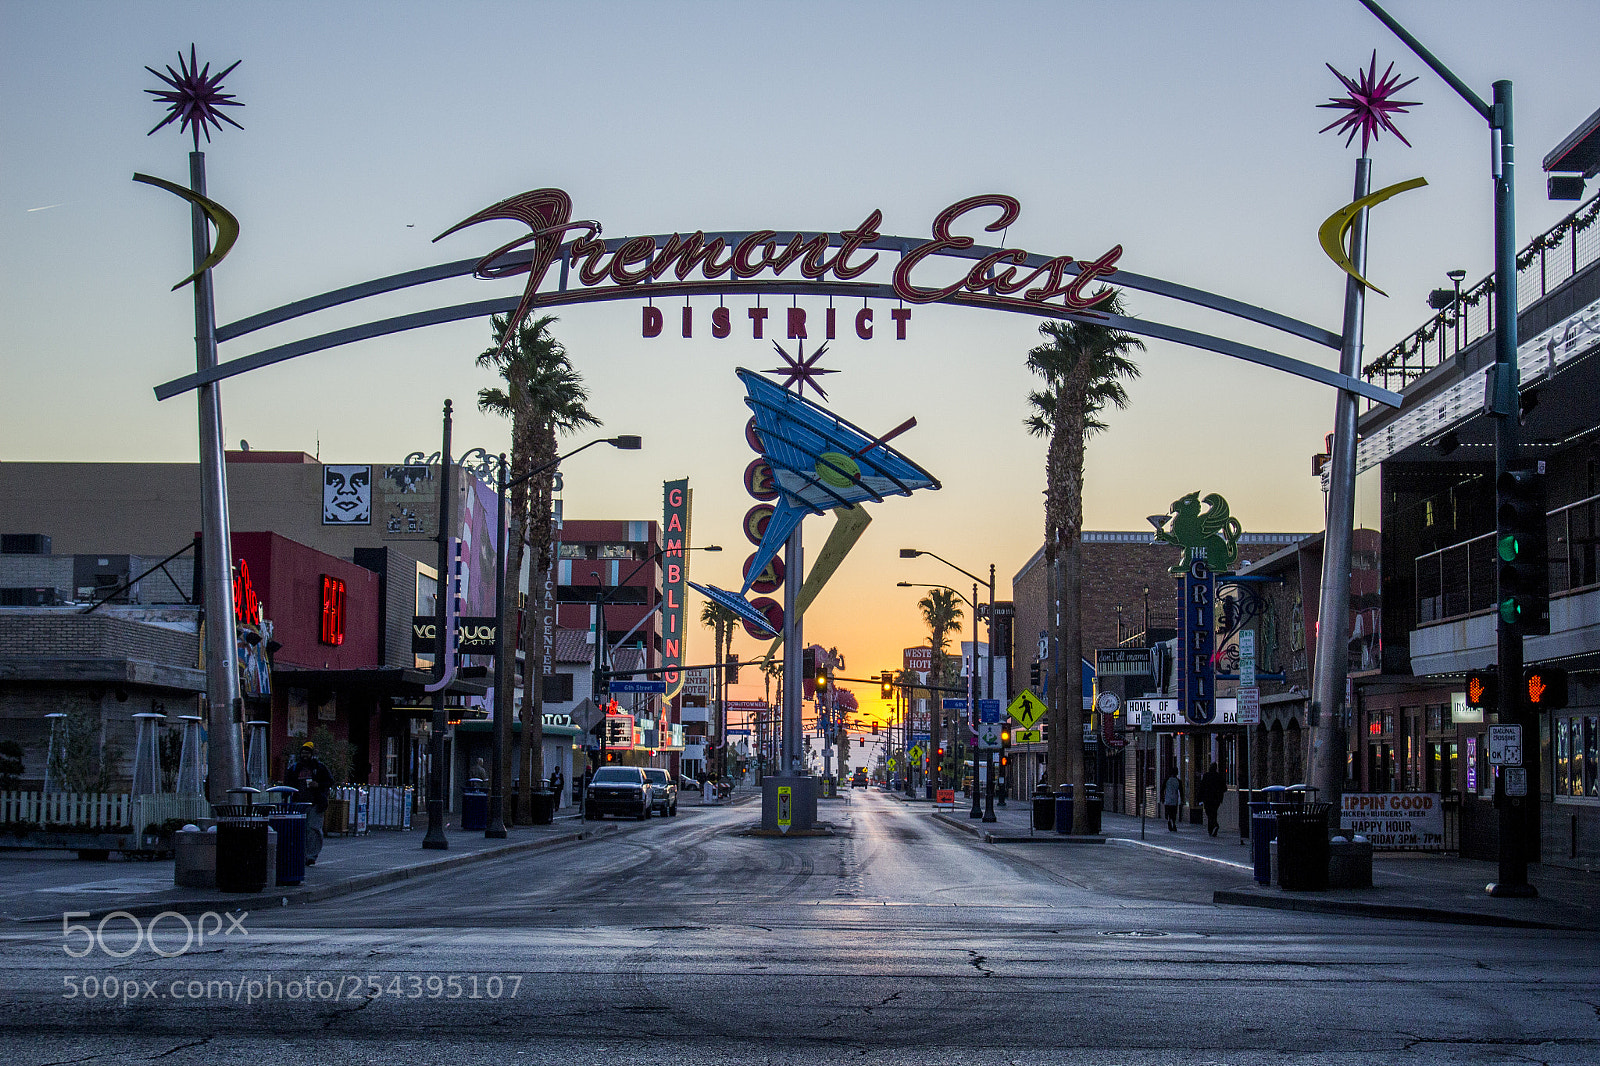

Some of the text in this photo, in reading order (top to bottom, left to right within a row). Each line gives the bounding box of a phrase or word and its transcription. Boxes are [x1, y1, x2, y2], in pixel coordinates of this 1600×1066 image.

[432, 188, 1123, 356] Fremont East
[642, 306, 912, 340] DISTRICT
[665, 489, 682, 684] GAMBLING
[543, 616, 553, 675] CENTER
[1191, 561, 1208, 719] GRIFFIN
[906, 648, 931, 658] WESTE
[682, 685, 708, 693] MOTEL
[1129, 702, 1168, 711] HOME OF
[1136, 713, 1176, 723] HANERO
[1341, 796, 1433, 810] IPPIN' GOOD
[1352, 821, 1411, 832] HAPPY HOUR
[1424, 833, 1441, 843] 7PM
